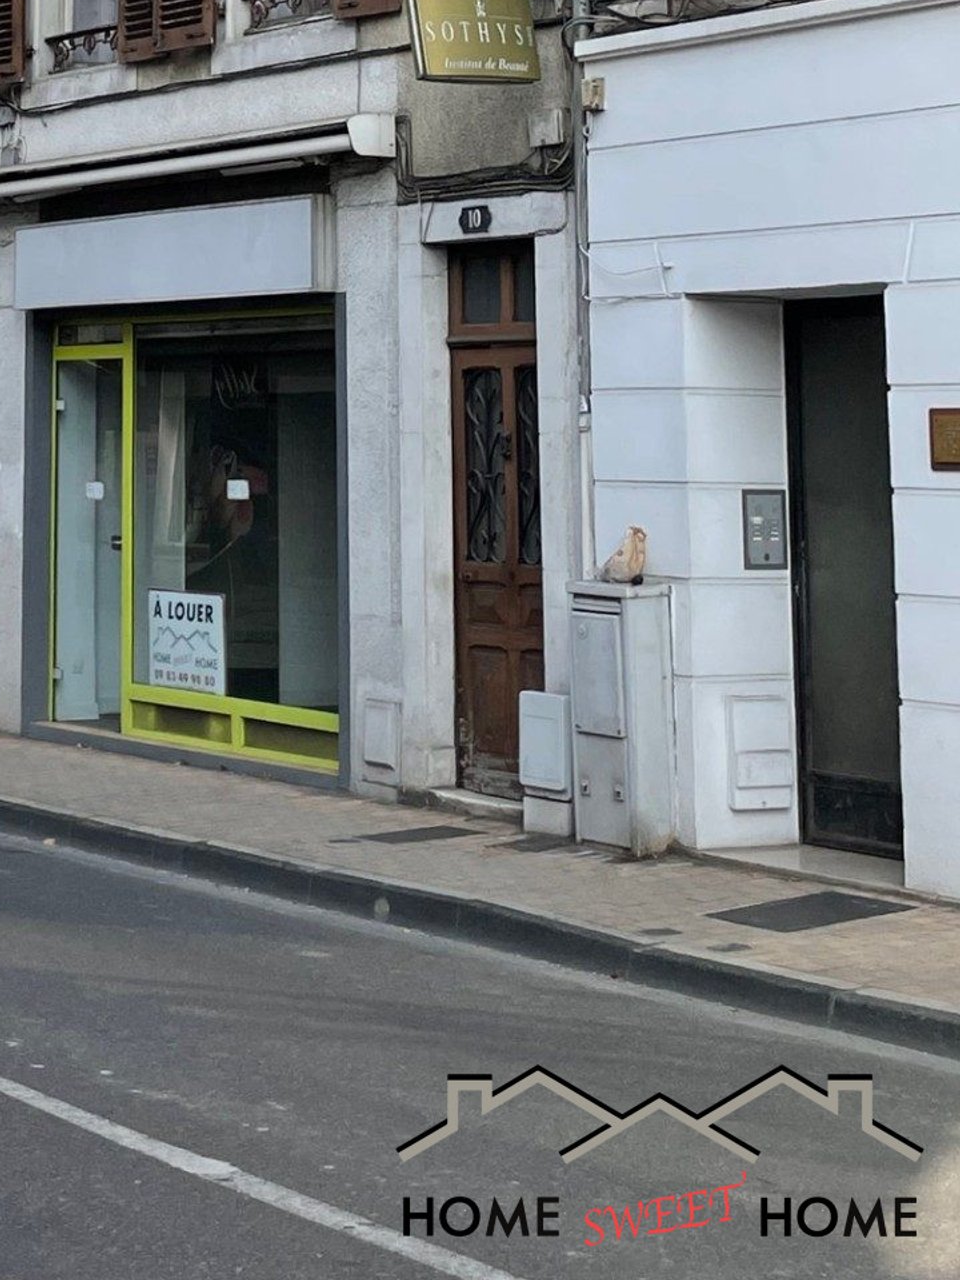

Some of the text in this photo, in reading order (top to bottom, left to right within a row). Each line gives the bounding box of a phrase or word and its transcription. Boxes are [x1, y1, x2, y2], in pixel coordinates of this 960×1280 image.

[424, 21, 524, 46] SOTHYS
[467, 208, 481, 228] 10
[168, 601, 214, 624] LOUER
